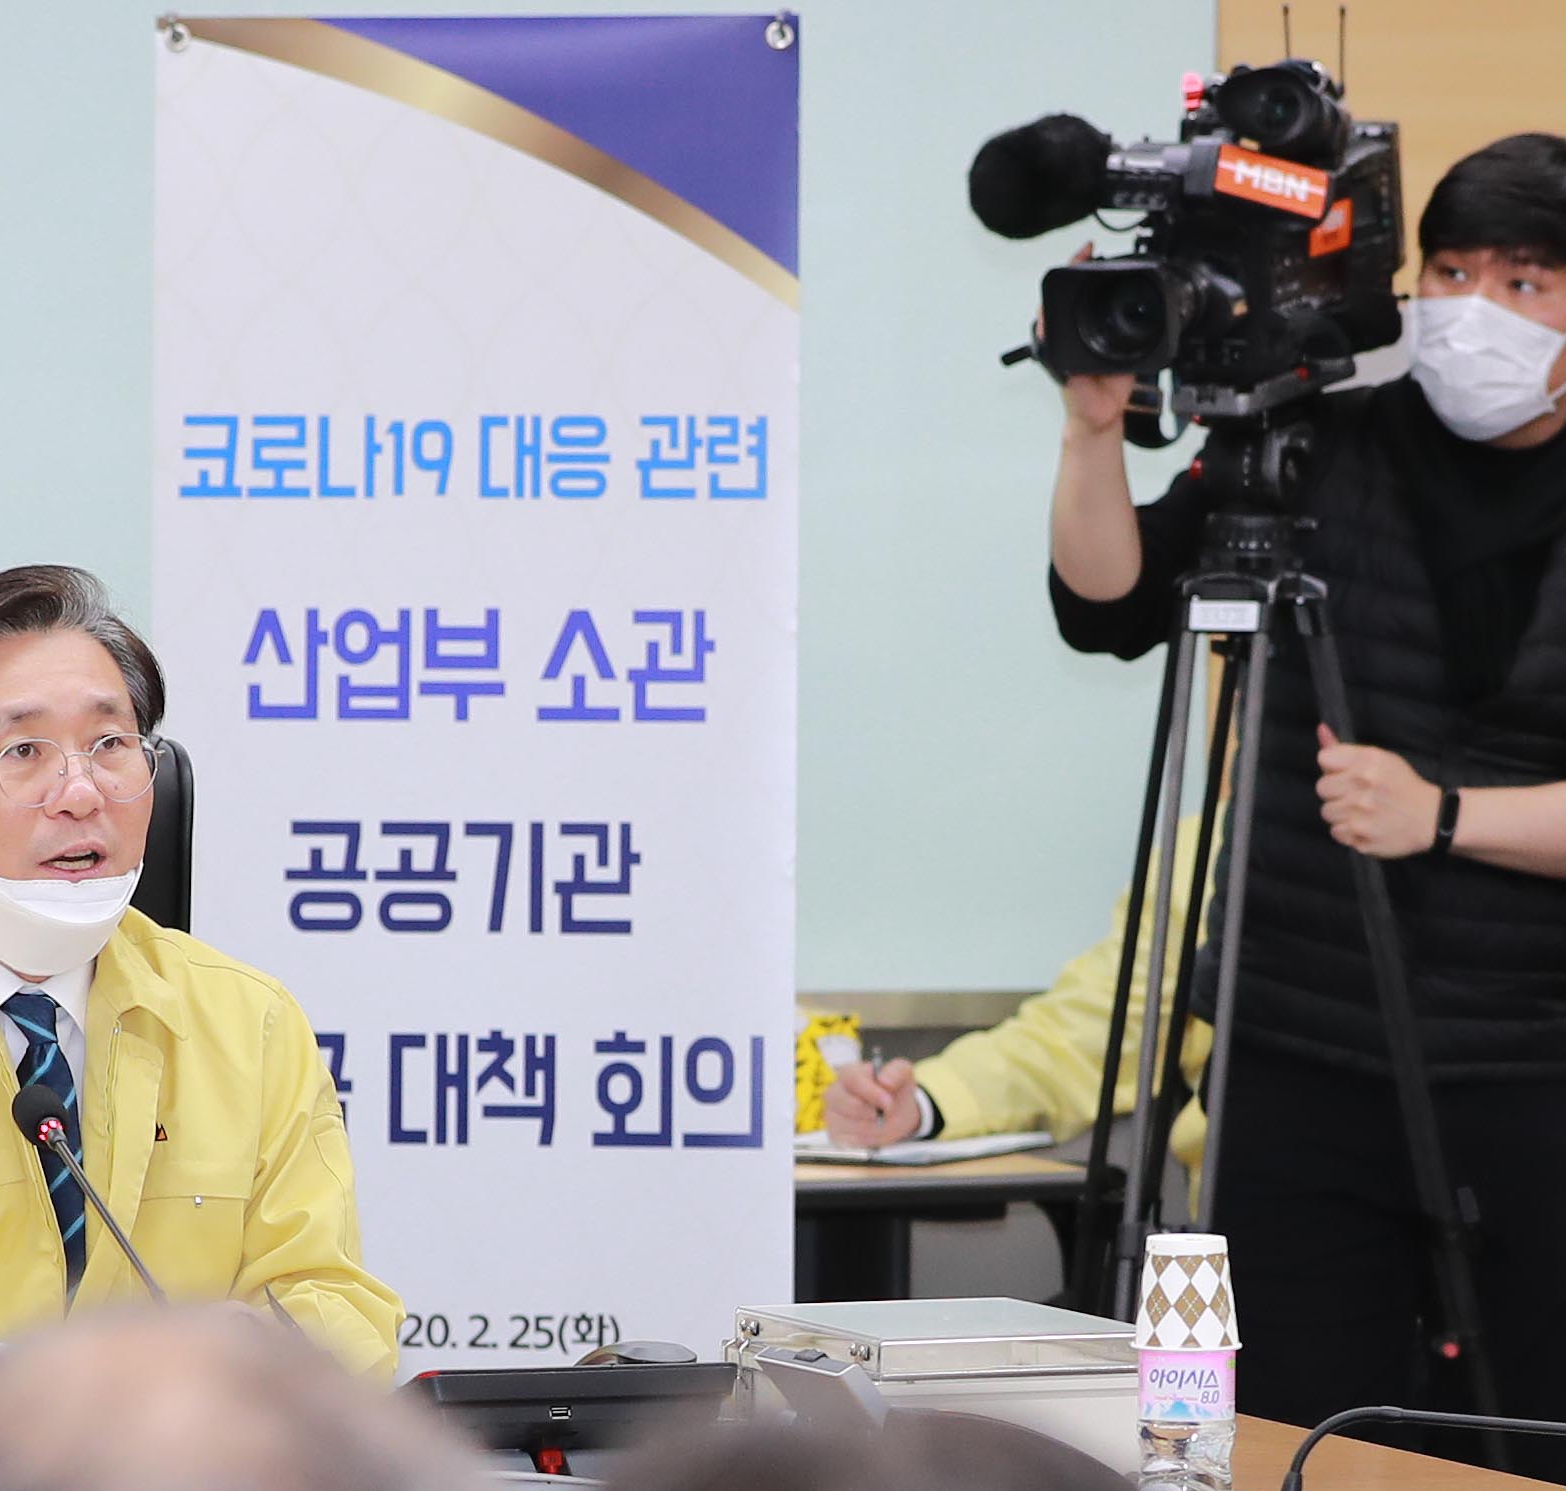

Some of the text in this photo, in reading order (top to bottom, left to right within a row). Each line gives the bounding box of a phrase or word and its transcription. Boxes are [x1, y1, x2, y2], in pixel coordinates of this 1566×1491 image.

[1233, 159, 1310, 202] MBN
[179, 415, 768, 500] 코로나19 대응 관련
[243, 608, 715, 722] 산업부 소관
[284, 820, 641, 935] 공공기관
[388, 1029, 556, 1147] 대책
[592, 1030, 764, 1149] 회의
[397, 1314, 458, 1348] 20.
[1149, 1368, 1219, 1390] 아이시스
